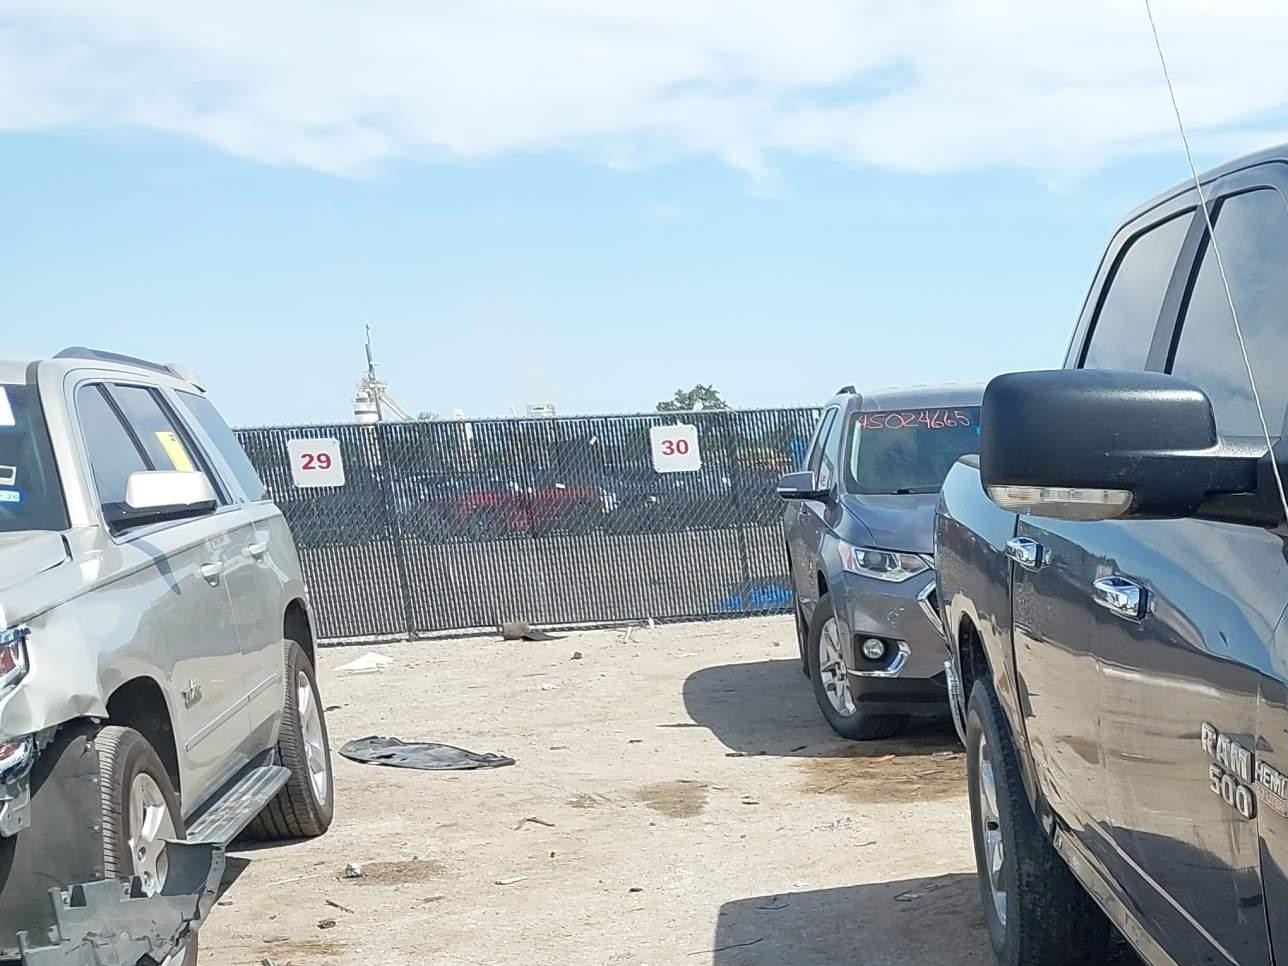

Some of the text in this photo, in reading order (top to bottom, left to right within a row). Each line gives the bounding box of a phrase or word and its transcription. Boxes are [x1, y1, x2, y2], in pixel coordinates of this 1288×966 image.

[858, 409, 970, 429] 45024665
[661, 438, 689, 456] 30
[300, 452, 332, 470] 29
[1201, 721, 1255, 784] RAM
